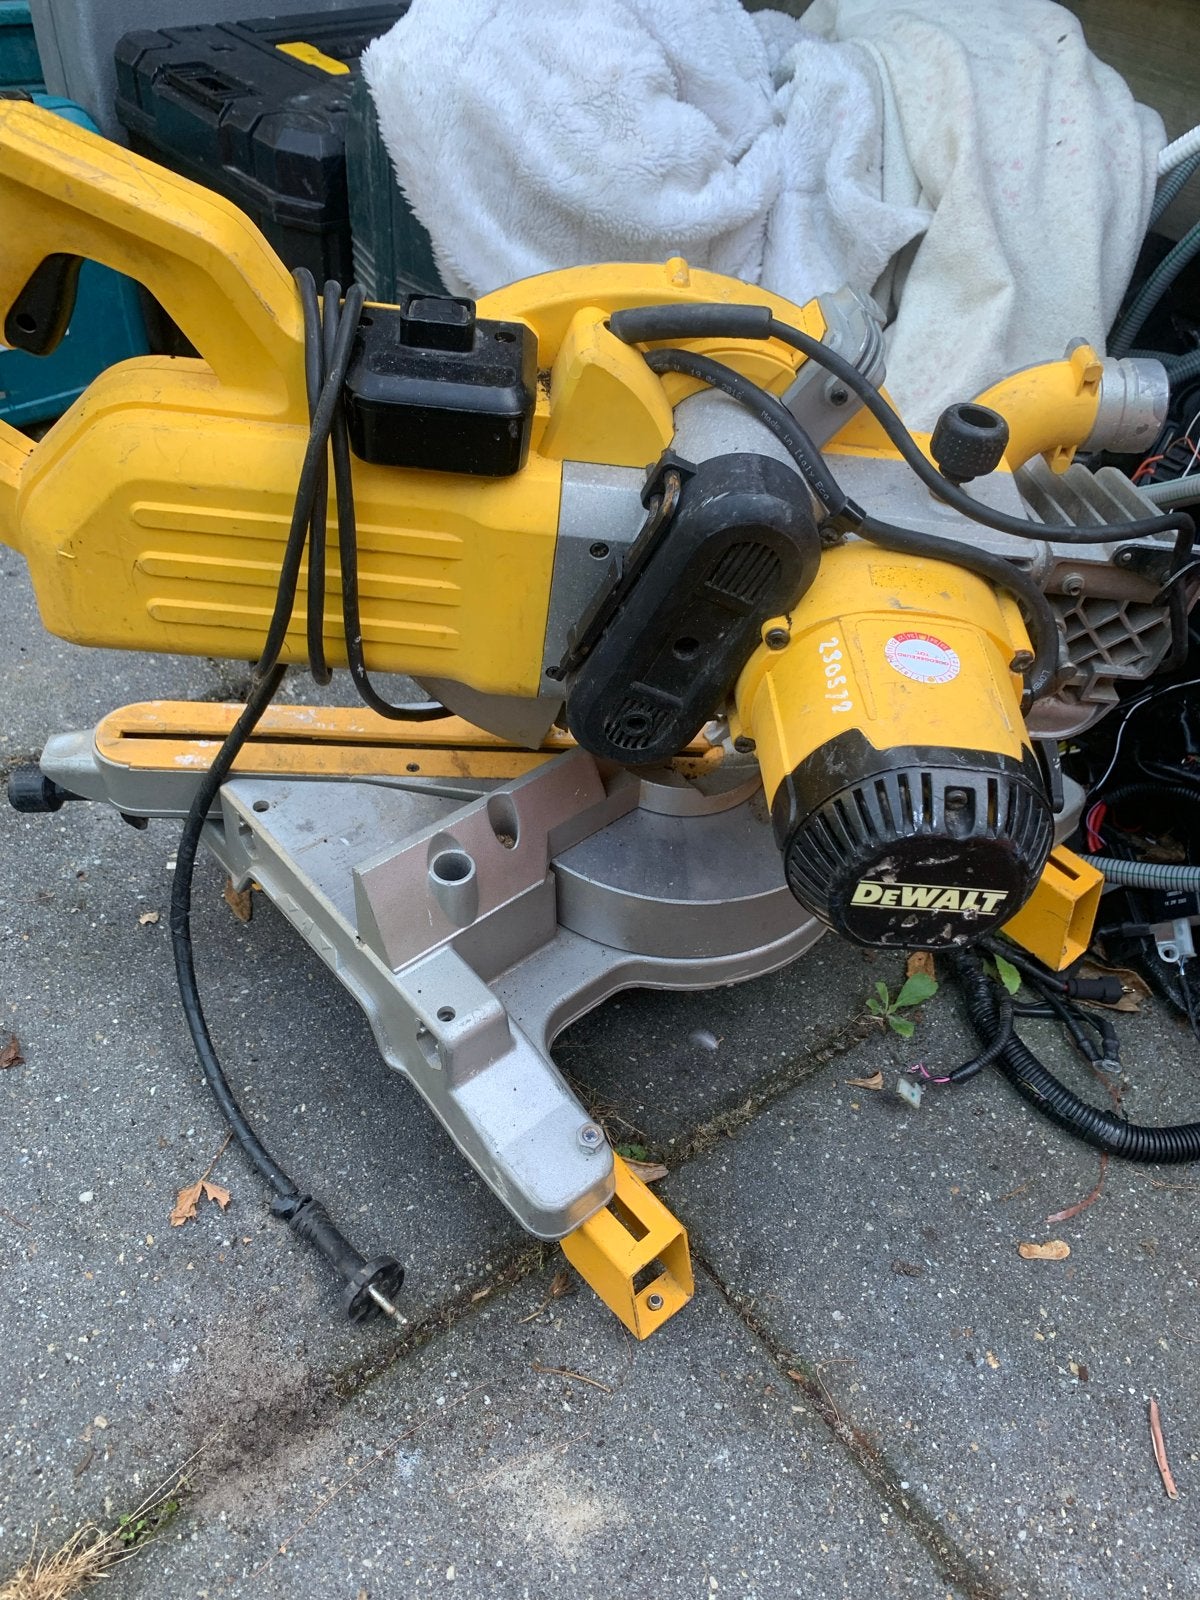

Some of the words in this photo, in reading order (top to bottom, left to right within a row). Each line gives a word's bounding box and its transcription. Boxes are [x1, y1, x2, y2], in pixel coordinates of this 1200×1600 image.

[761, 410, 779, 430] Made
[783, 434, 793, 446] in
[794, 449, 815, 477] Italy
